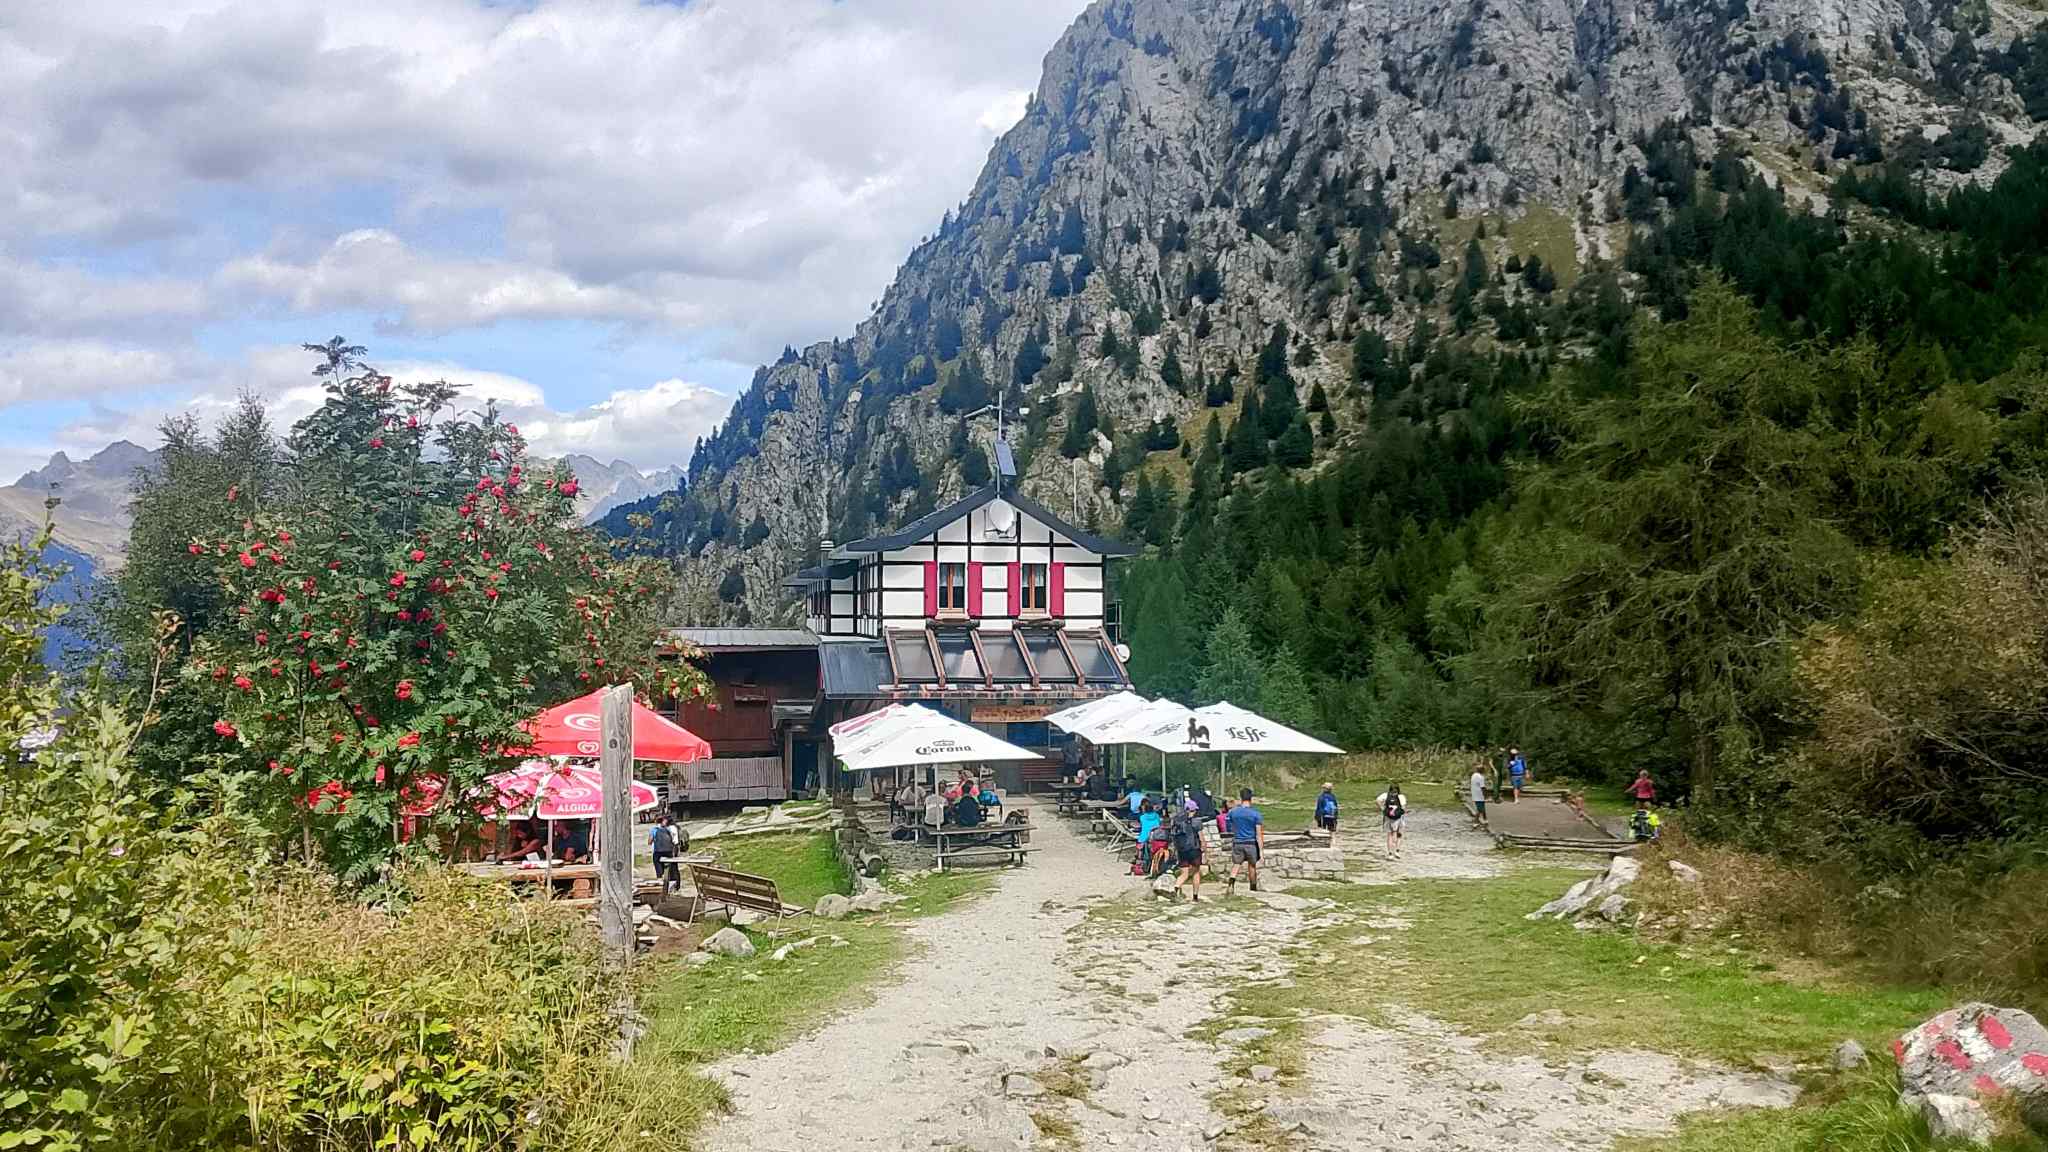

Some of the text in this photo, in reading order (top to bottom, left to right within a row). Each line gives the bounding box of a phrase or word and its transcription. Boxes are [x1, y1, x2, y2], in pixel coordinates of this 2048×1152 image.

[1225, 727, 1268, 742] Leffe
[915, 746, 972, 755] Corona
[557, 803, 595, 812] ALGIDA
